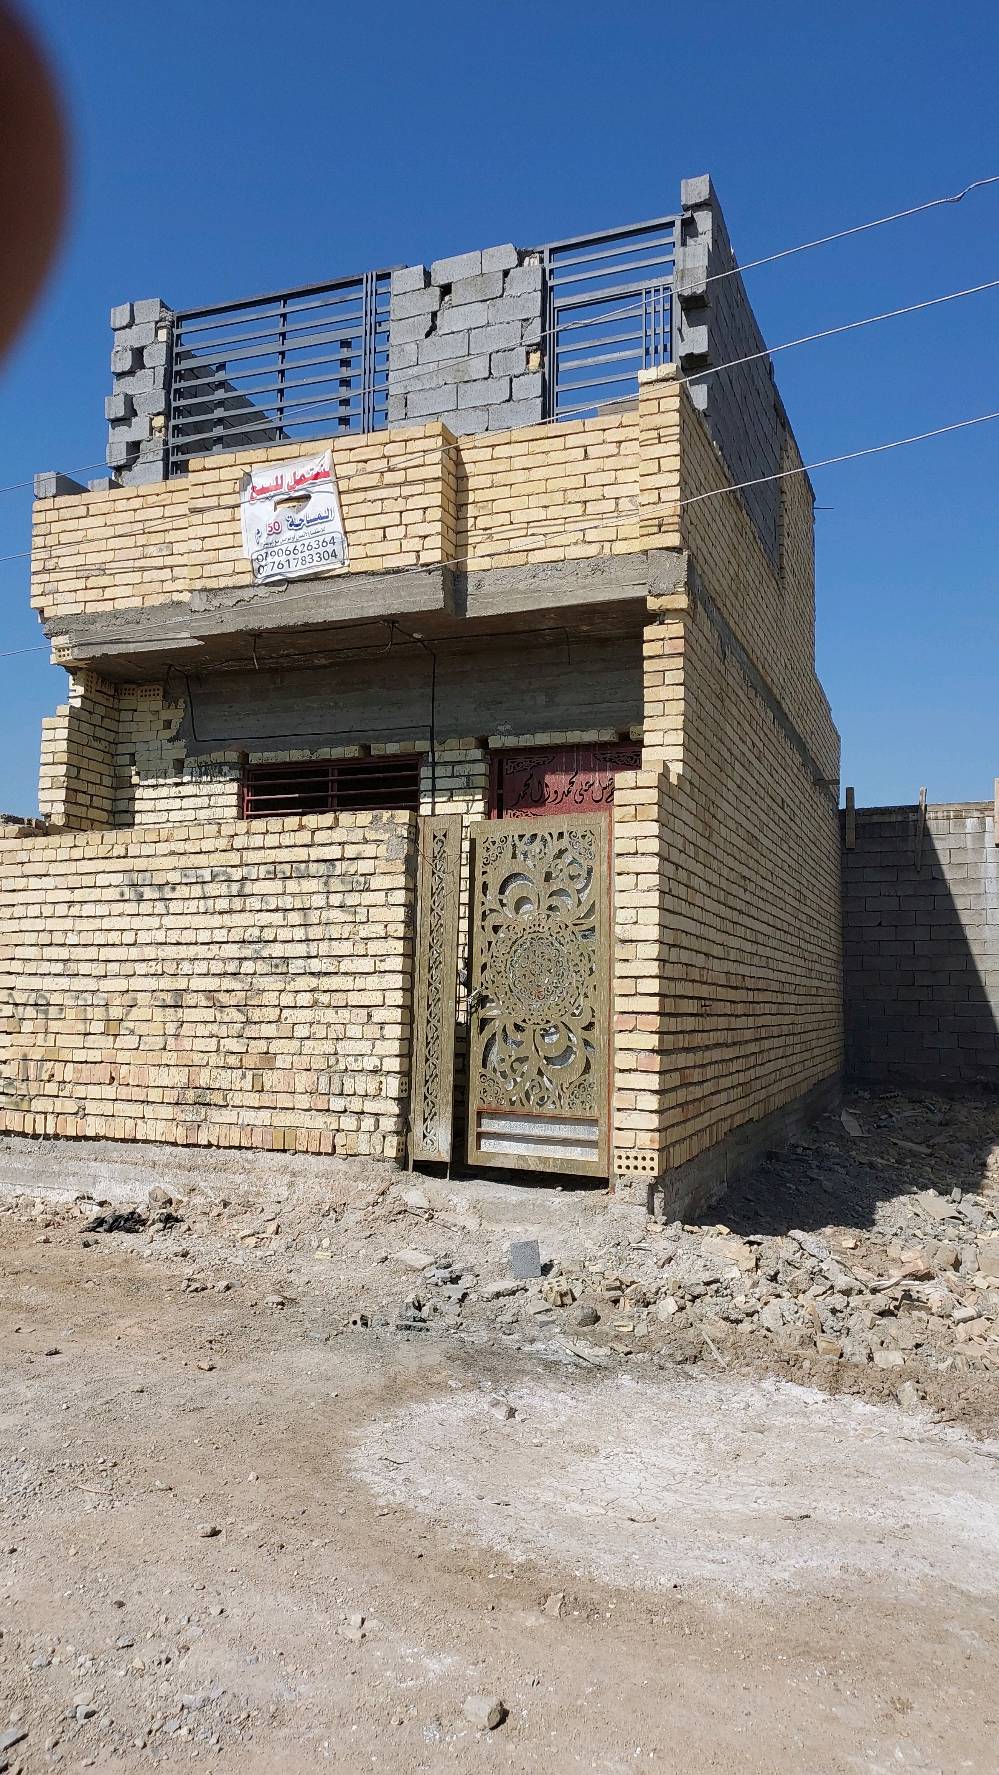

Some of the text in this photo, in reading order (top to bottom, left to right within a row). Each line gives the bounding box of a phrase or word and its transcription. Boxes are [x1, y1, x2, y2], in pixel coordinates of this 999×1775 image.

[250, 463, 331, 501] مشتمل للبيع
[266, 521, 282, 536] 50
[286, 505, 335, 530] المساحة
[256, 535, 337, 563] 07906626364
